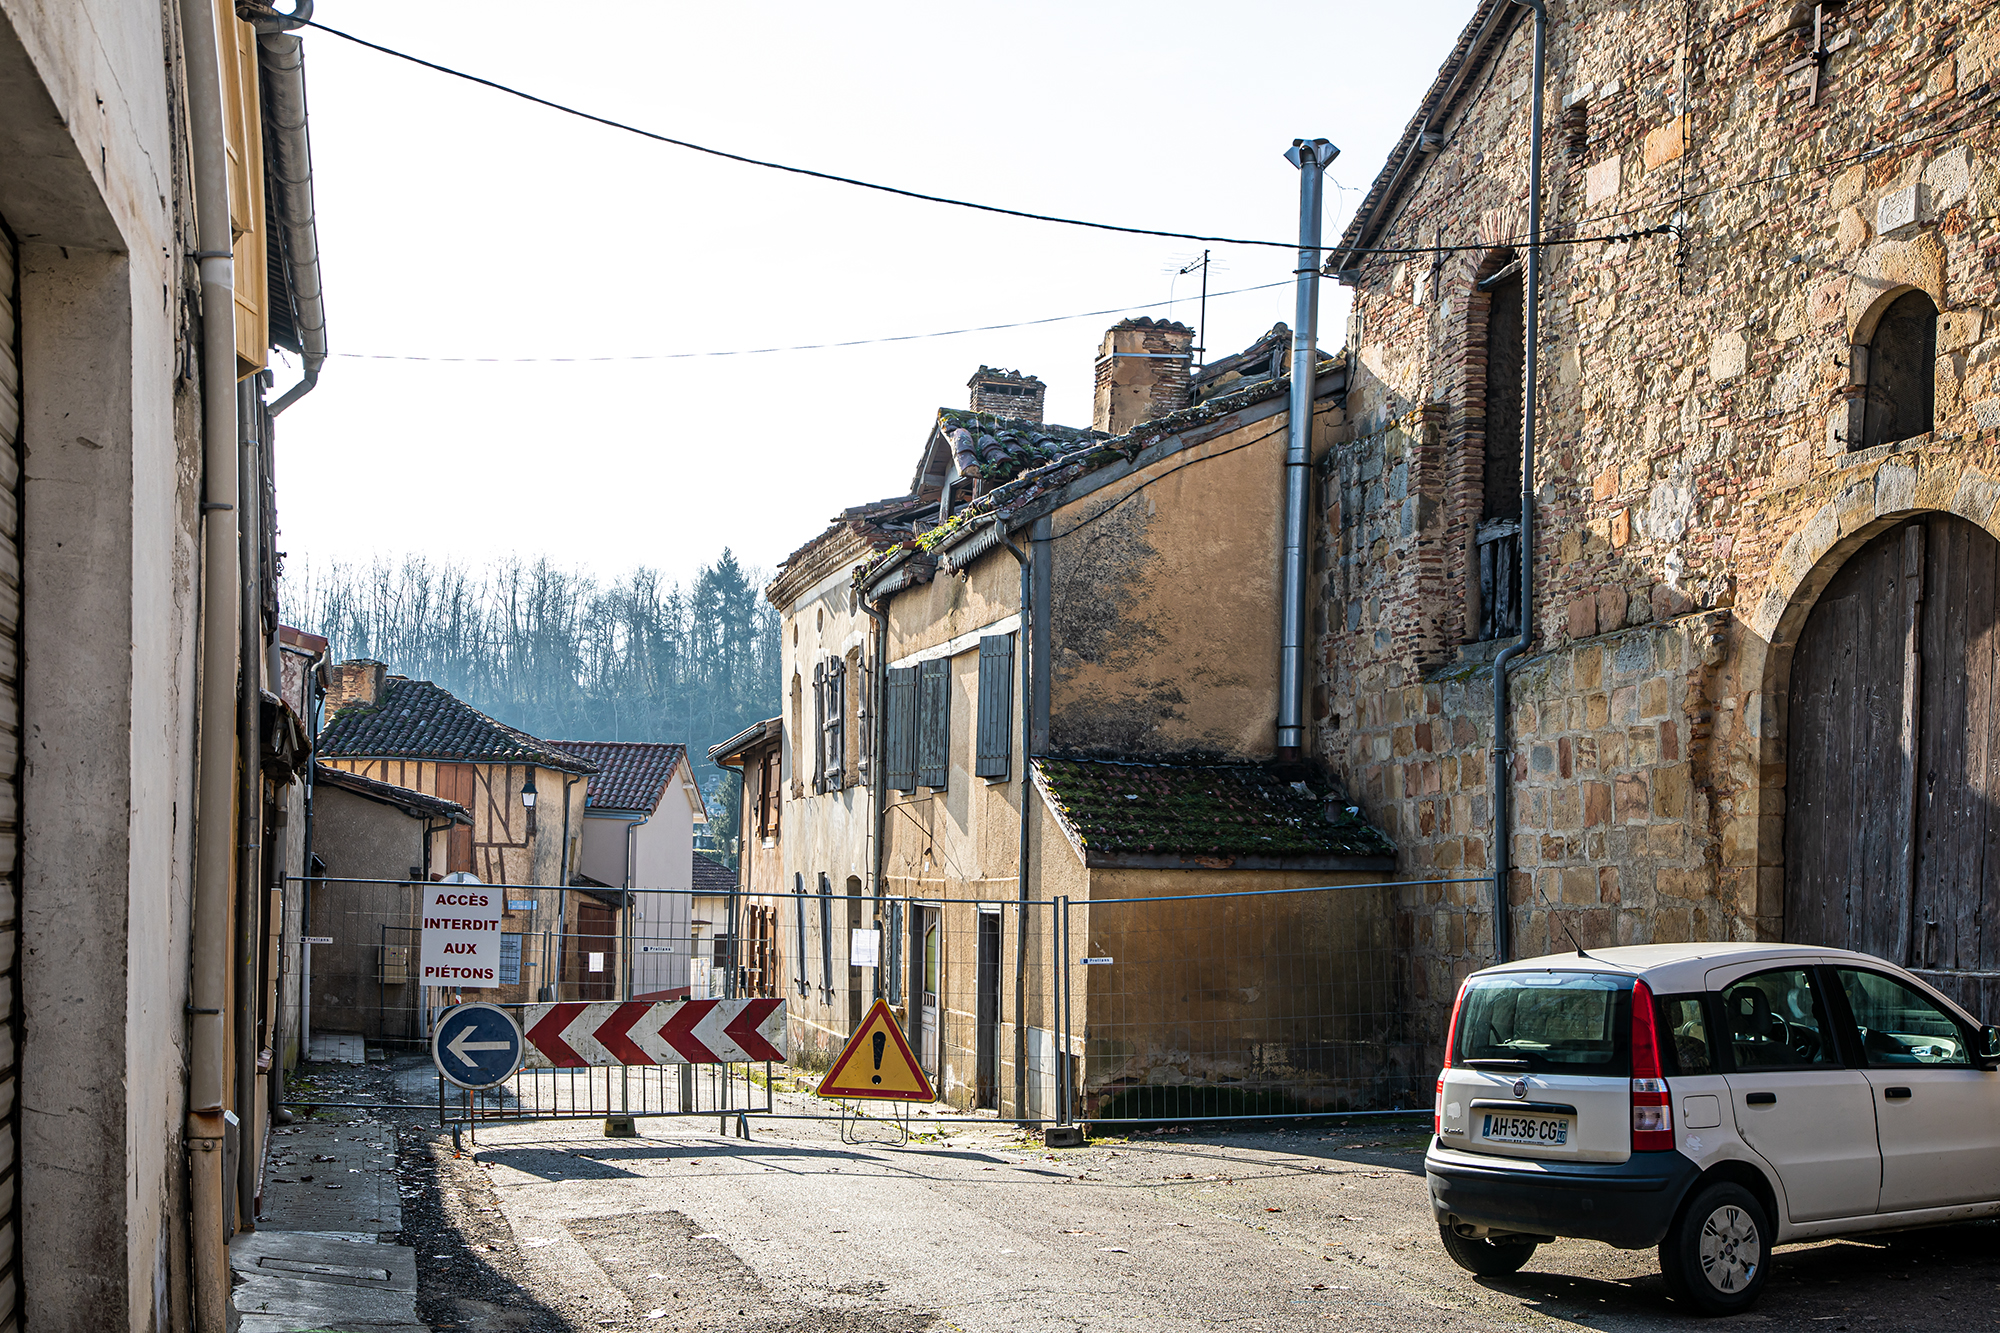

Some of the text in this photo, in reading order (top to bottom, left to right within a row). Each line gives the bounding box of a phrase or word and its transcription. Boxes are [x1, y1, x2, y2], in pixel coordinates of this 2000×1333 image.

[435, 893, 489, 907] ACCÈS
[424, 918, 499, 931] INTERDIT
[443, 943, 477, 955] AUX
[425, 964, 494, 979] PIÉTONS
